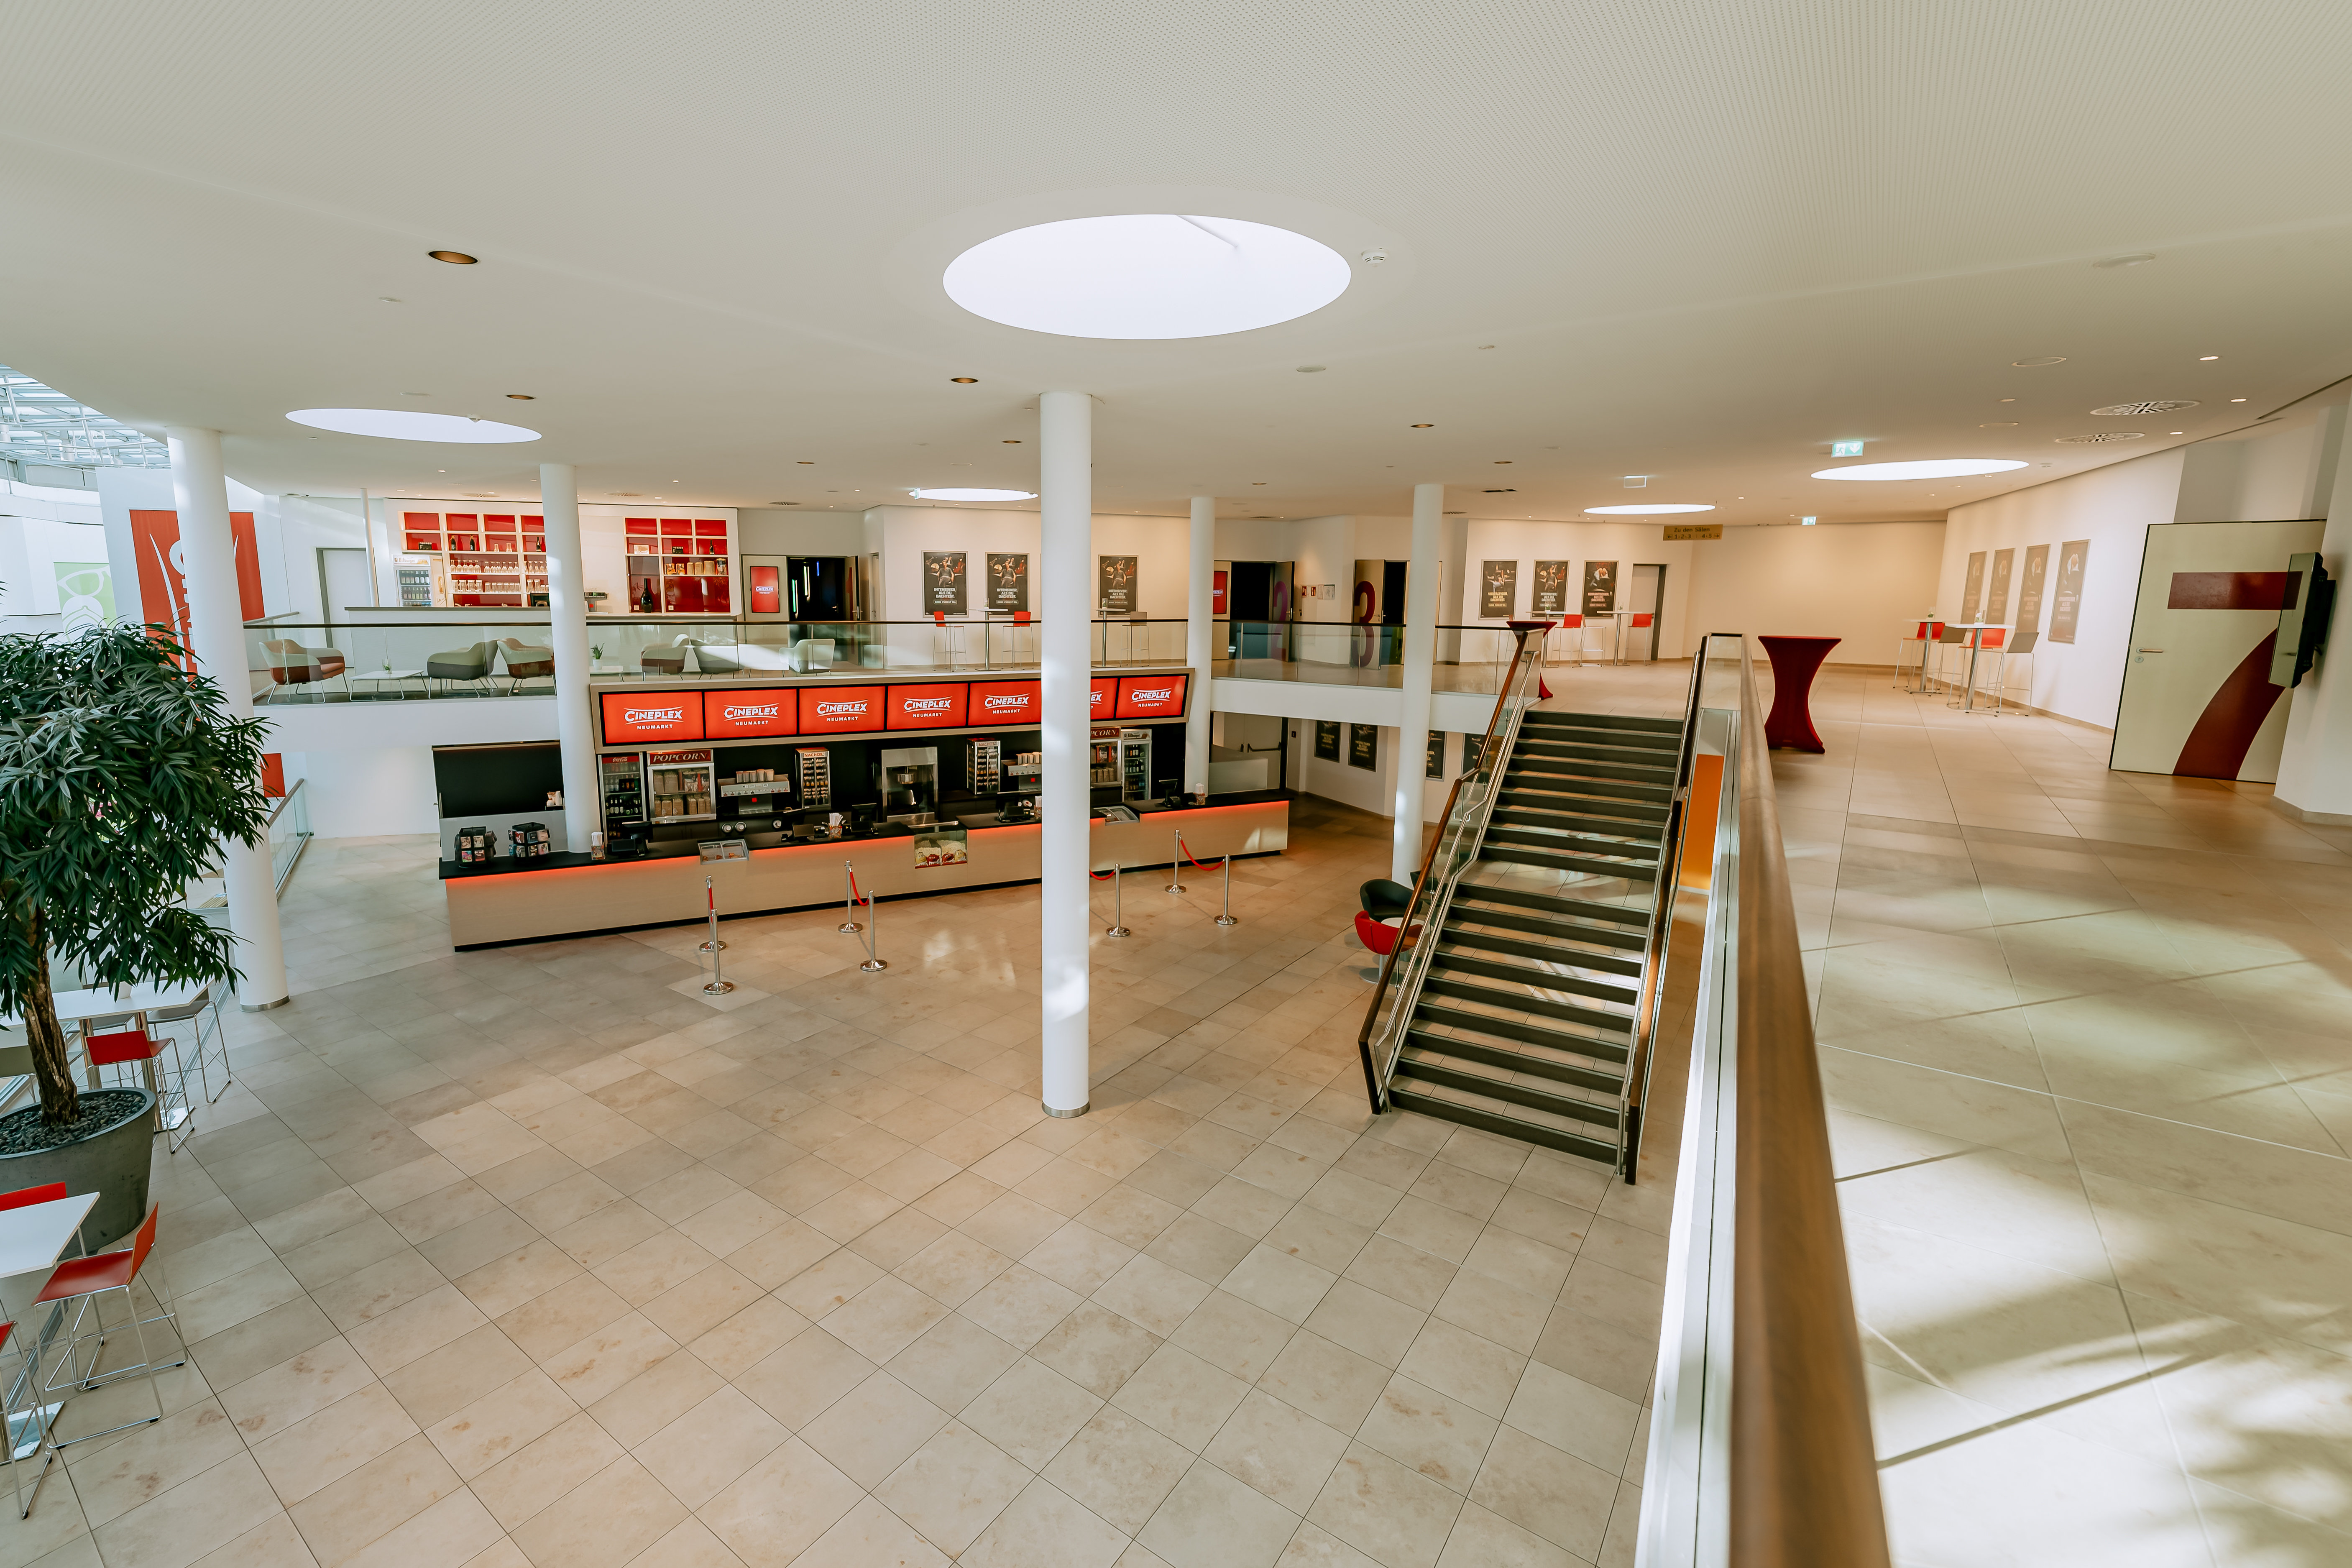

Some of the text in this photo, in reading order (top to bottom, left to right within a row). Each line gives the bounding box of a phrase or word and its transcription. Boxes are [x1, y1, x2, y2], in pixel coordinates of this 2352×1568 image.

[1352, 581, 1376, 667] 3
[985, 696, 1029, 707] CINEPLEX
[1132, 691, 1171, 701] CINEPLEX
[817, 703, 868, 714] CINEPLEX
[904, 700, 951, 710] CINEPLEX
[624, 710, 683, 721] CINEPLEX
[724, 706, 778, 718] CINEPLEX
[653, 753, 707, 762] POPCORN
